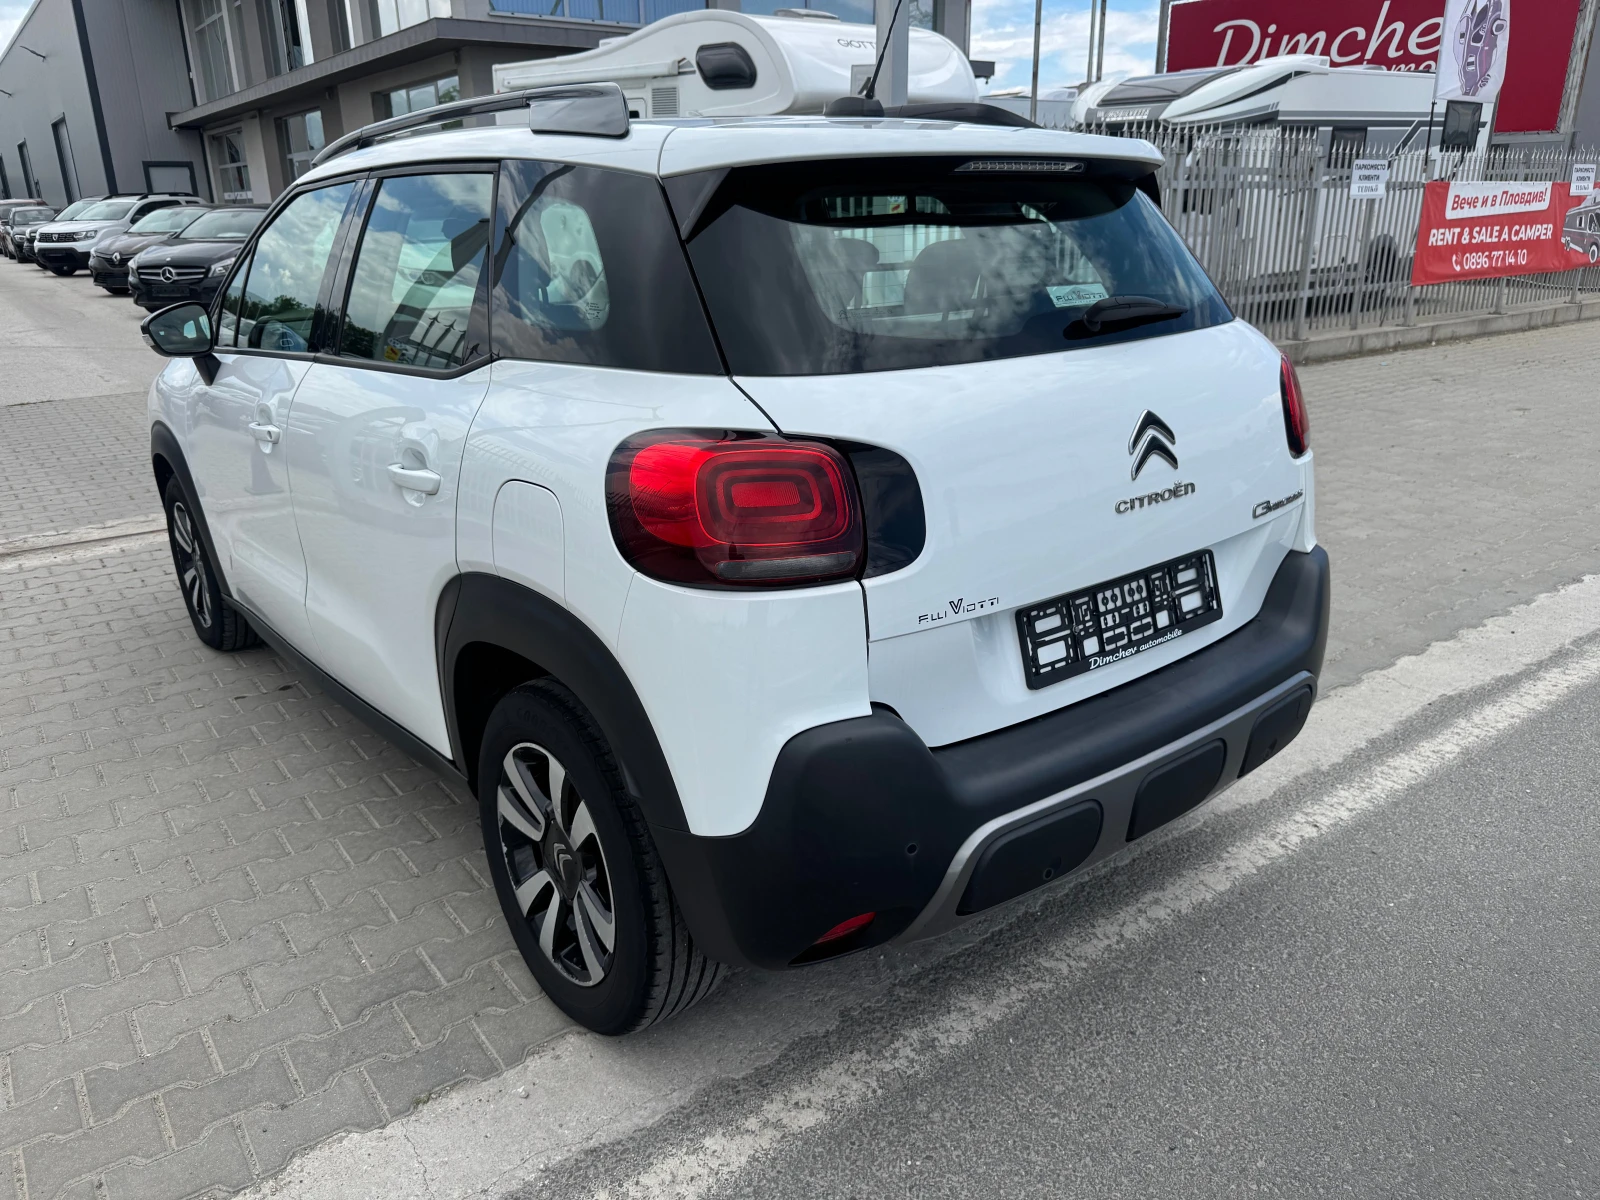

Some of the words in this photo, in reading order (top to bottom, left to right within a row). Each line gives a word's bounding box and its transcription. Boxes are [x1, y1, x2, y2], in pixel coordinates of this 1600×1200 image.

[837, 38, 876, 49] GIOTT
[1213, 0, 1444, 67] Dimche
[1451, 194, 1479, 211] Вече
[1480, 195, 1489, 208] и
[1490, 194, 1498, 207] в
[1498, 187, 1548, 206] Пловдив!
[1428, 227, 1461, 246] RENT
[1461, 226, 1470, 245] &
[1471, 225, 1500, 244] SALE
[1500, 225, 1509, 242] A
[1511, 223, 1553, 241] CAMPER
[1463, 251, 1489, 270] 0896
[1491, 250, 1503, 267] 77
[1505, 249, 1515, 266] 14
[1517, 249, 1527, 265] 10
[1089, 646, 1137, 670] Dimchev
[1139, 628, 1183, 652] automobile
